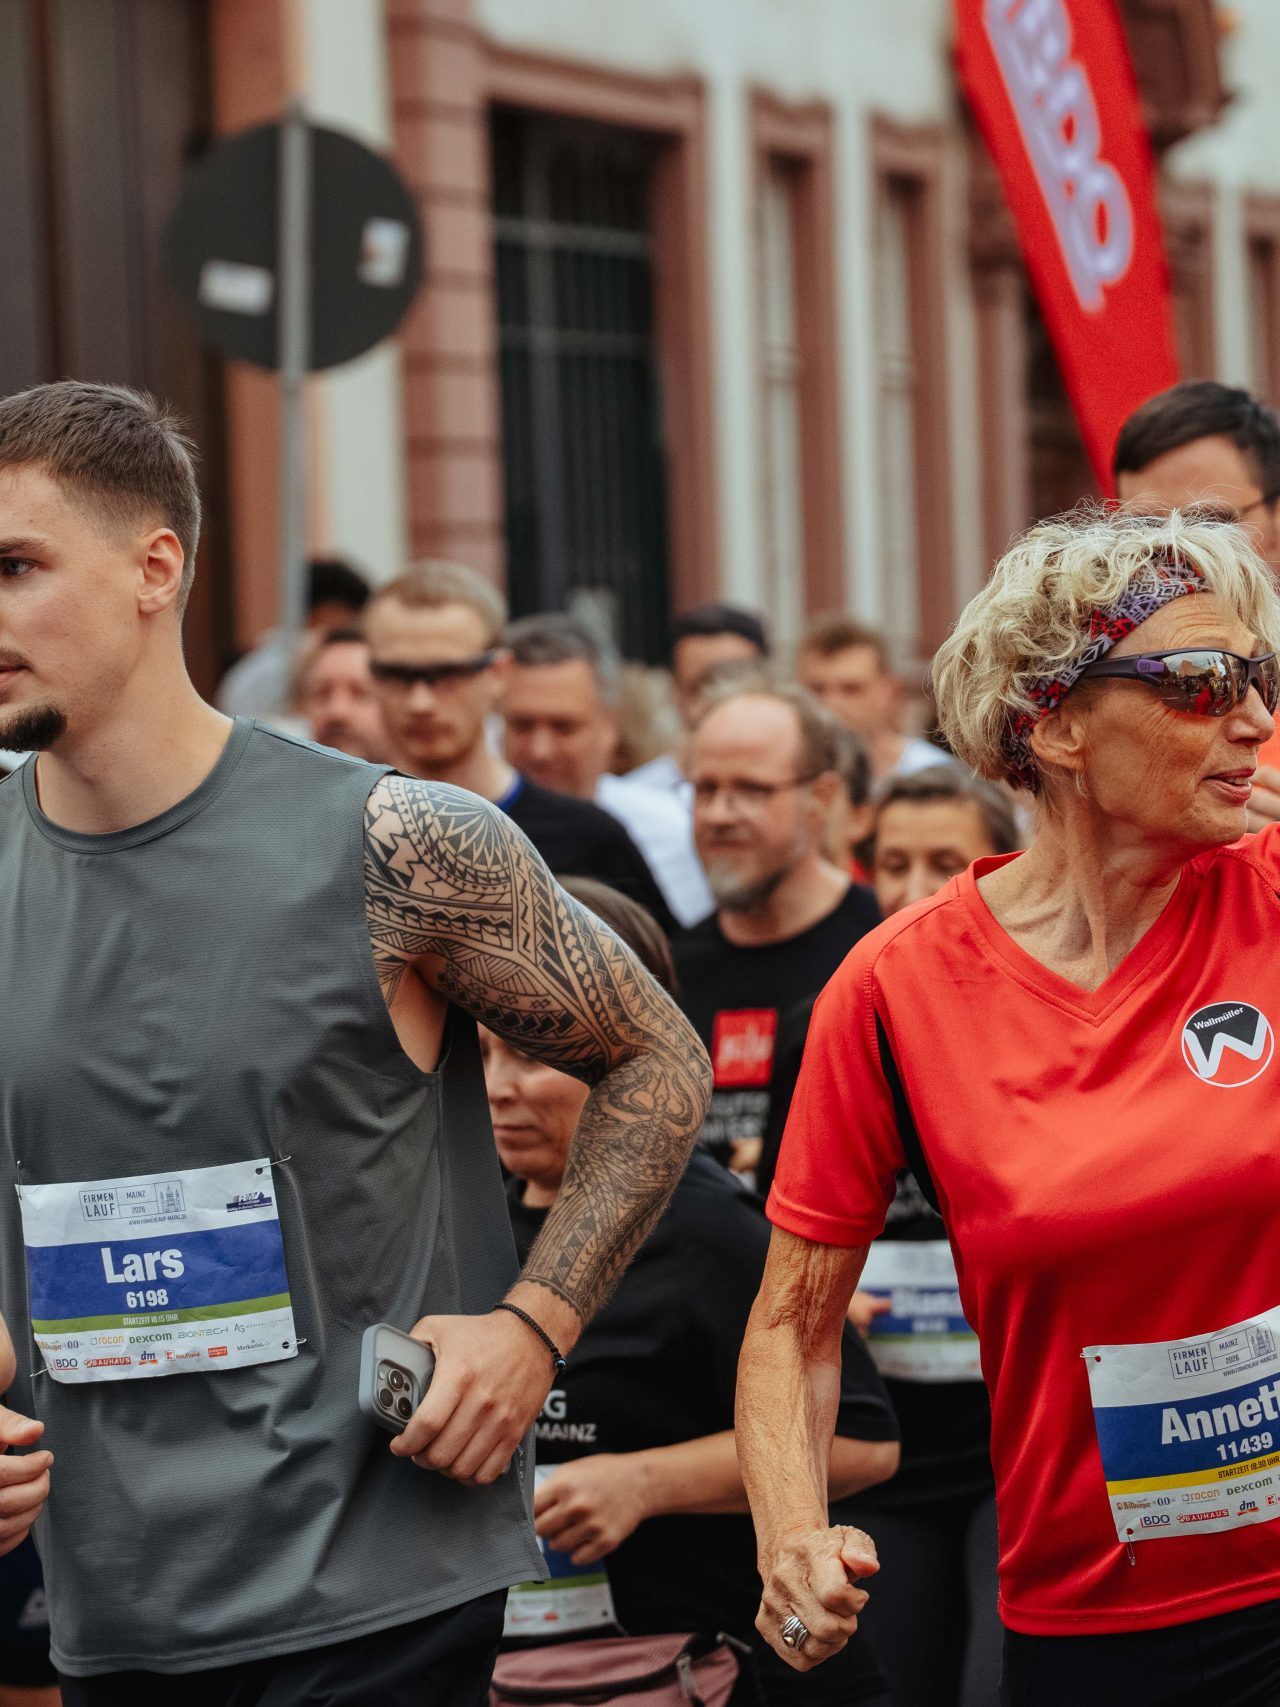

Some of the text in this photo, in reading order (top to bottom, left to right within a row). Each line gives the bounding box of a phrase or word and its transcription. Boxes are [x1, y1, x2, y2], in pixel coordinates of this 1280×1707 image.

[1193, 1007, 1244, 1030] Wallmüller
[83, 1192, 114, 1203] FIRMEN
[126, 1190, 146, 1199] MAINZ
[85, 1203, 115, 1218] LAUF
[100, 1247, 185, 1284] Lars
[126, 1288, 169, 1309] 6198
[122, 1316, 150, 1326] STARTZEIT
[165, 1313, 179, 1322] UHR
[1173, 1346, 1207, 1361] FIRMEN
[1219, 1338, 1238, 1351] MAINZ
[56, 1358, 78, 1368] BDO
[93, 1357, 131, 1367] BAUHAUS
[141, 1350, 156, 1361] dm
[1175, 1357, 1209, 1375] LAUF
[540, 1389, 567, 1420] G
[1216, 1432, 1273, 1461] 11439
[1217, 1465, 1249, 1479] STARTZEIT
[1268, 1456, 1280, 1466] UHR
[1143, 1515, 1170, 1526] BDO
[1185, 1509, 1229, 1522] BAUHAUS
[1239, 1500, 1256, 1511] dm
